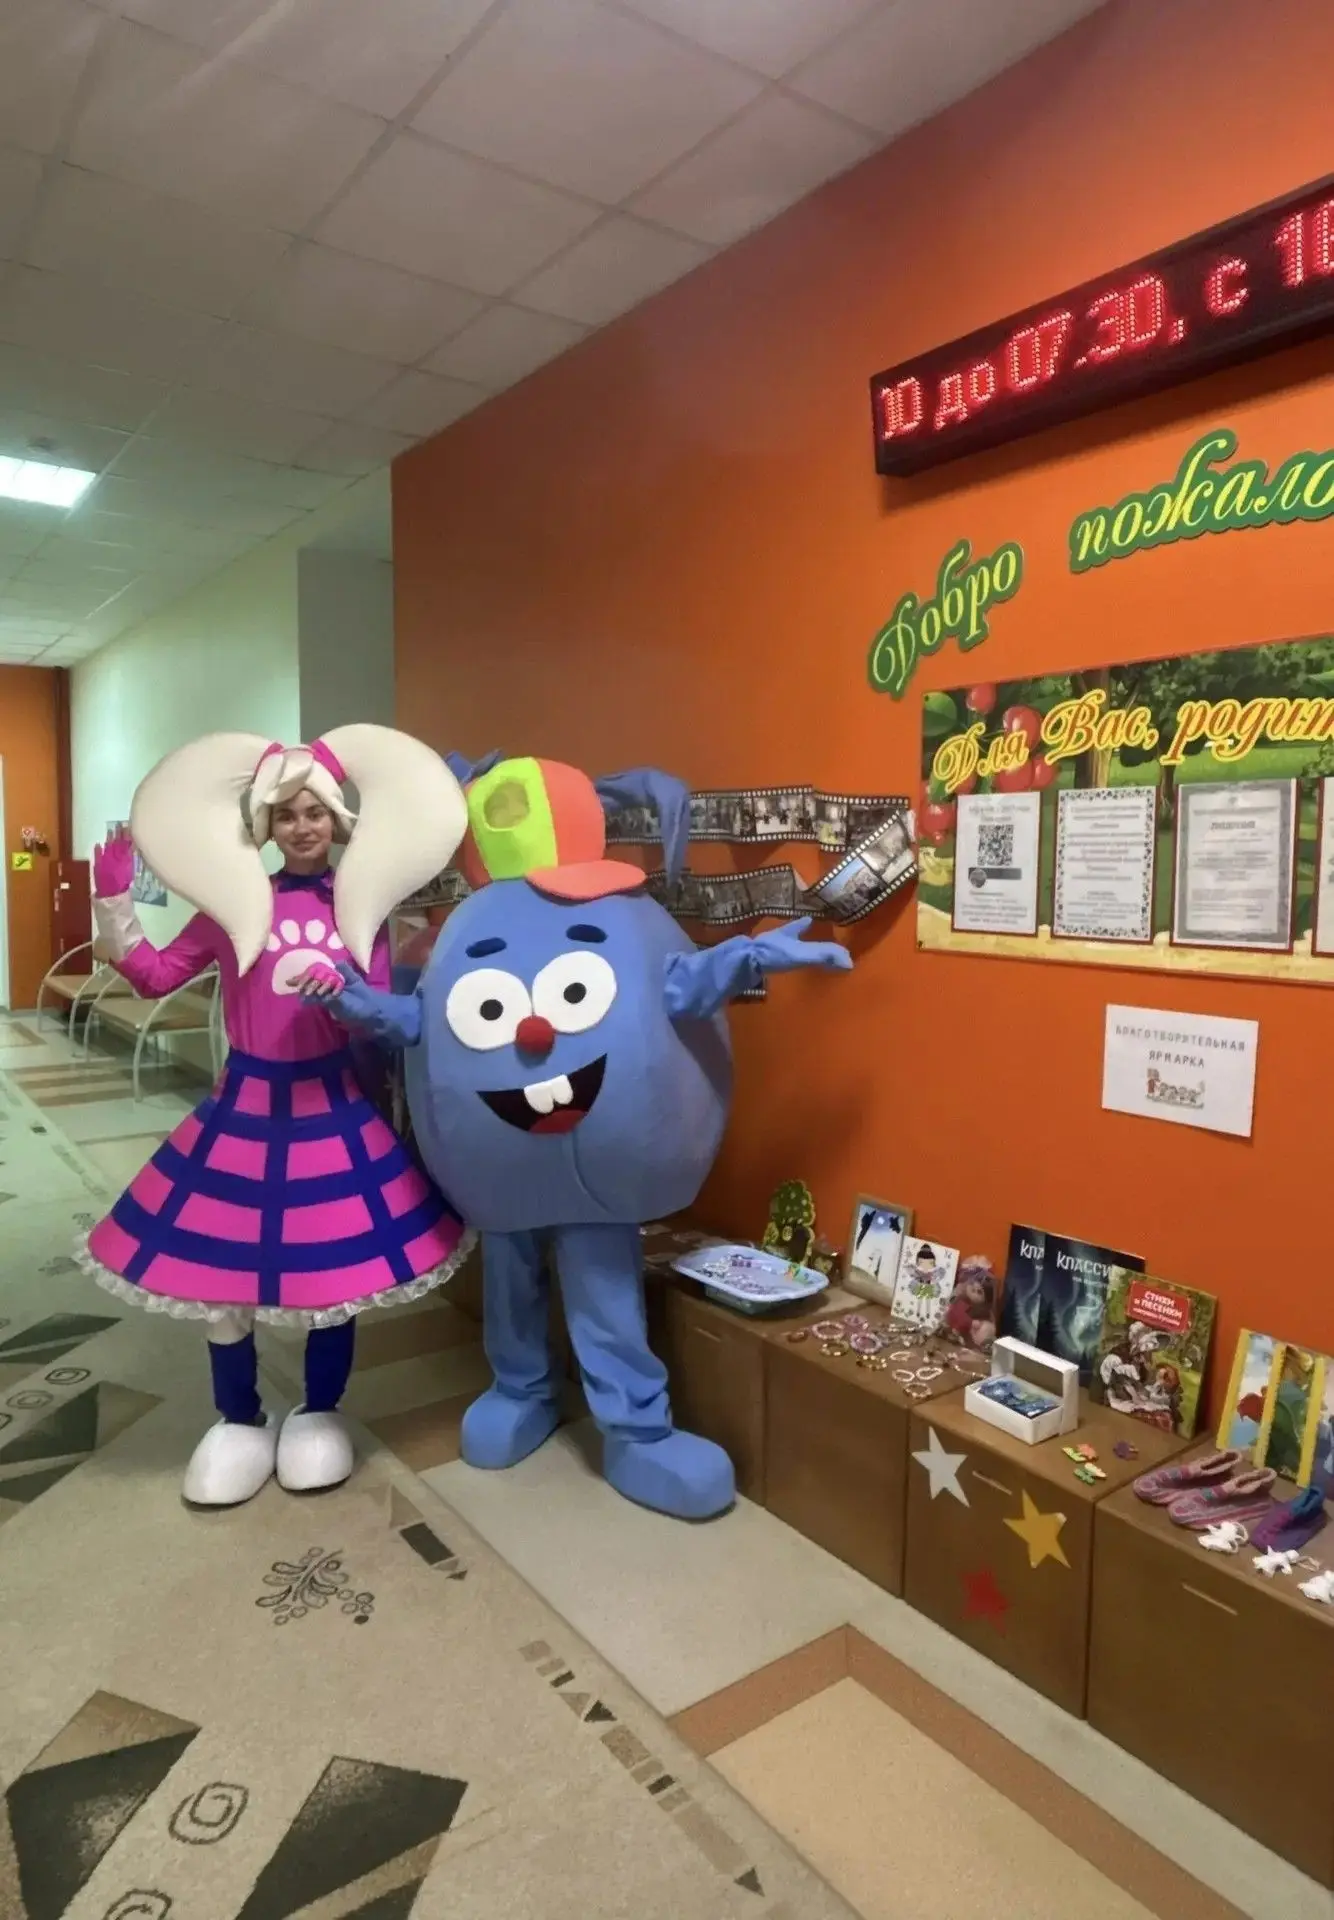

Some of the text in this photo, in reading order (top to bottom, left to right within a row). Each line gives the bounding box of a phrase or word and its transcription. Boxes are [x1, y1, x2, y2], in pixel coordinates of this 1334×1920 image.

[881, 376, 923, 440] 10
[934, 362, 996, 430] до
[870, 434, 1334, 696] Добро пожало
[933, 722, 1029, 793] Для
[1041, 689, 1159, 765] Вас,
[1115, 1025, 1246, 1052] БЛАГОТВОРИТЕЛЬНАЯ
[1148, 1049, 1206, 1069] ЯРМАРКА
[1141, 1298, 1183, 1321] ПЕСЕНКИ
[1144, 1290, 1175, 1308] СТИХИ
